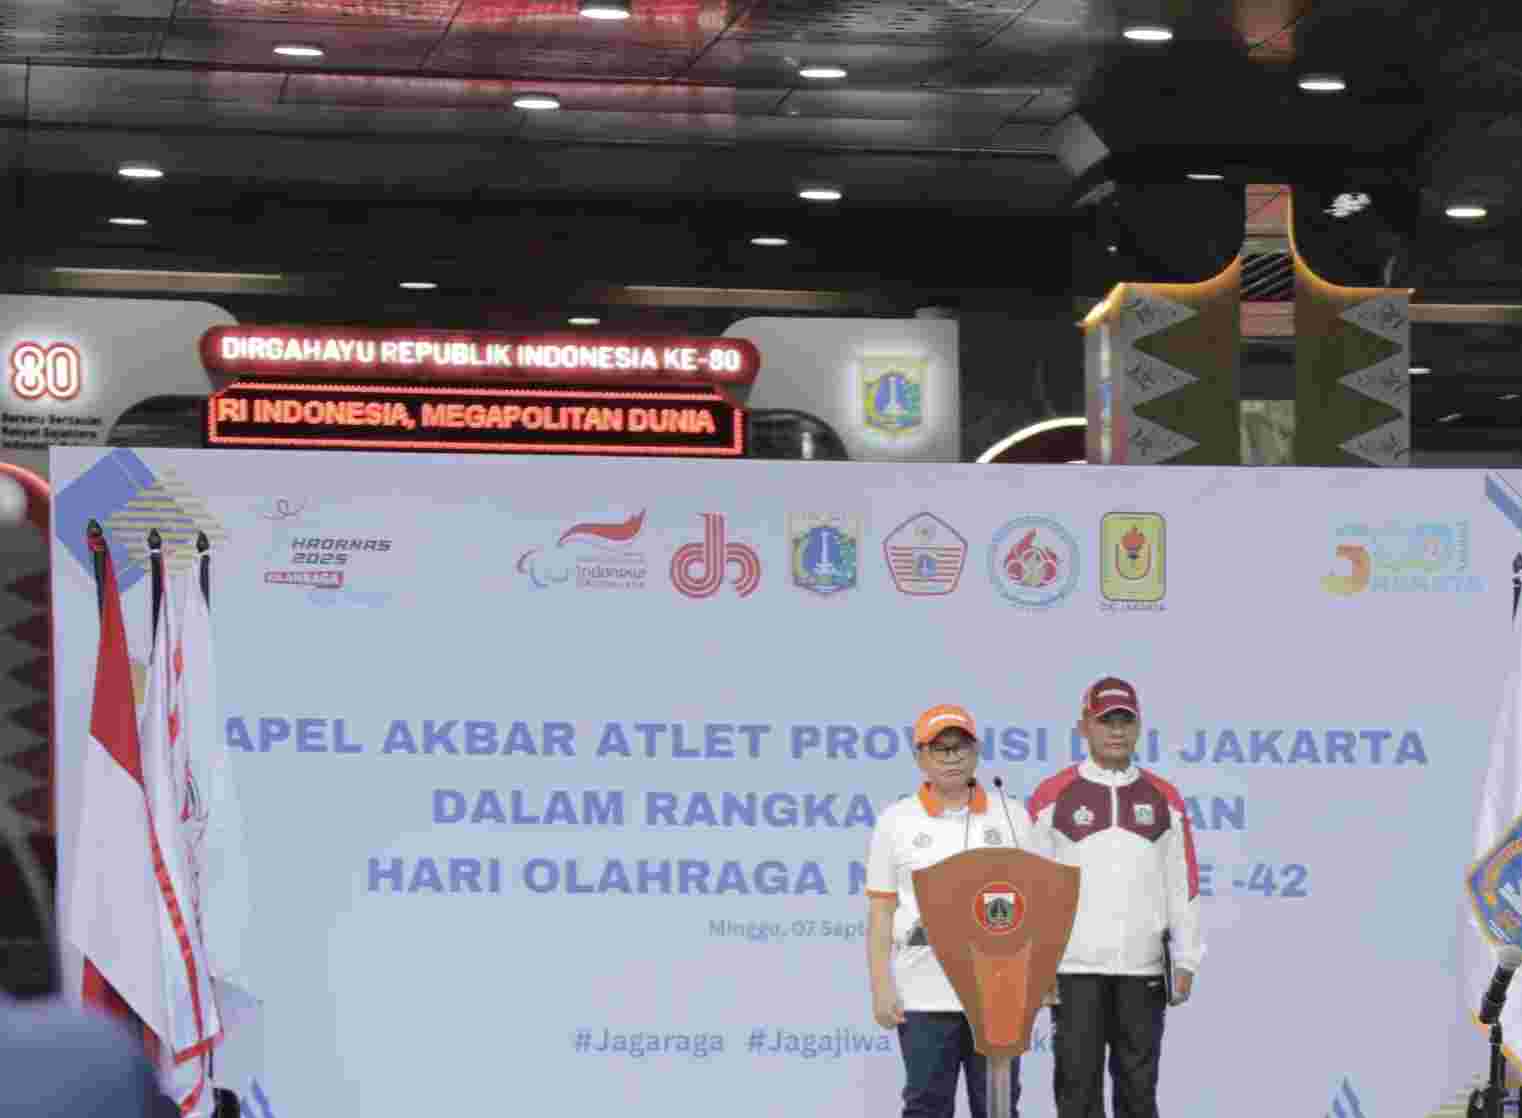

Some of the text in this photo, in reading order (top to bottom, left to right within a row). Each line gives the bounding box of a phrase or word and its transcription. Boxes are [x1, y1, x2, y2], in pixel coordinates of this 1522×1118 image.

[10, 341, 81, 400] 80
[221, 336, 740, 371] DIRGAHAYU REPUBLIK INDONESIA KE-80
[217, 398, 714, 433] RI INDONESIA, MEGAPOLITAN DUNIA
[291, 553, 348, 565] 2025
[225, 717, 363, 752] APEL
[382, 719, 577, 756] AKBAR
[596, 722, 771, 759] ATLET
[1181, 729, 1429, 765] JAKARTA
[432, 789, 877, 828] DALAM RANGKA
[367, 857, 501, 893] HARI
[523, 858, 828, 895] OLAHRAGA
[1232, 864, 1309, 897] -42
[574, 1029, 891, 1057] #Jagaraga #Jagajiwa
